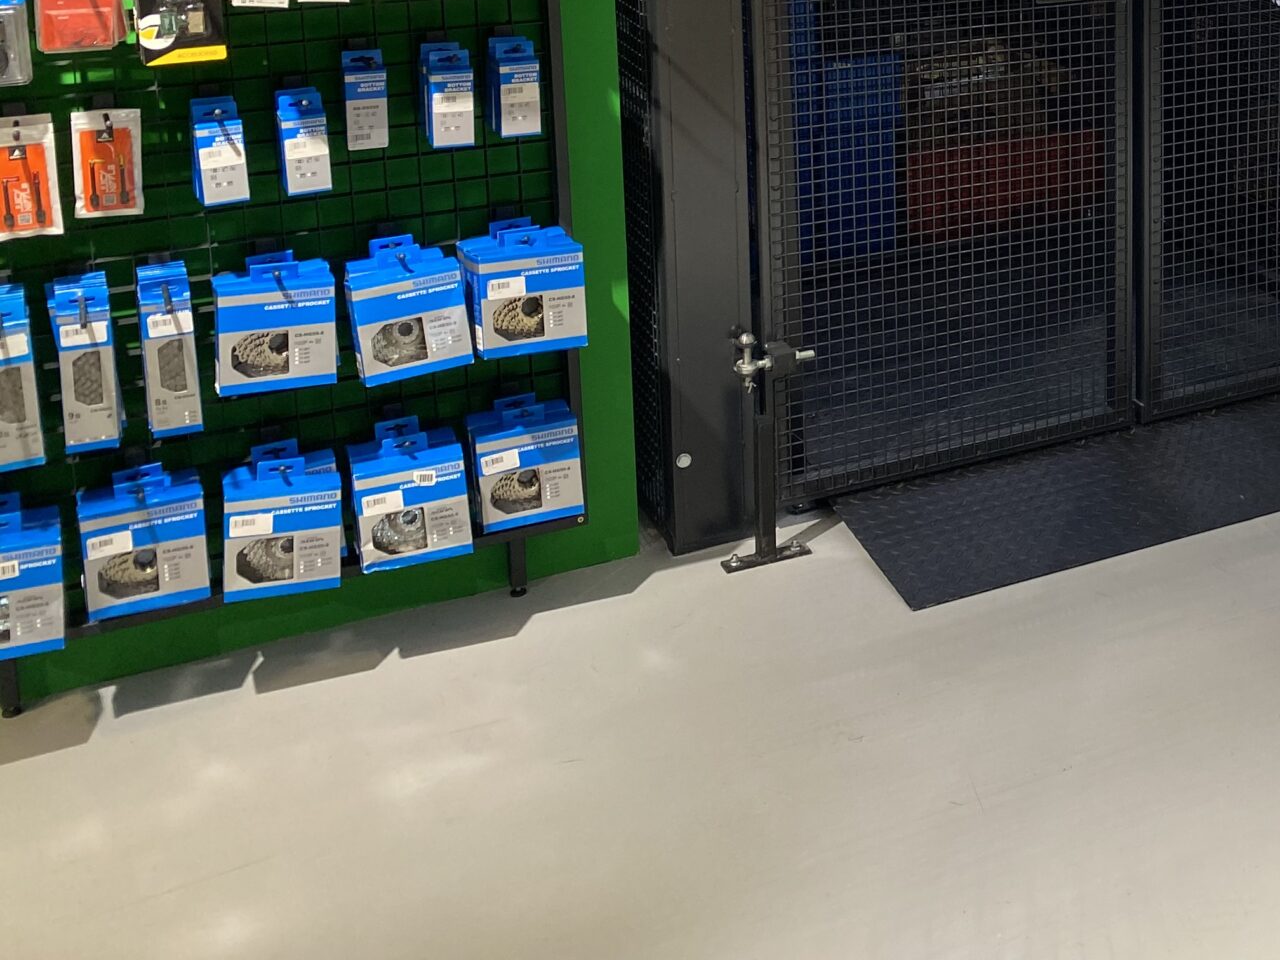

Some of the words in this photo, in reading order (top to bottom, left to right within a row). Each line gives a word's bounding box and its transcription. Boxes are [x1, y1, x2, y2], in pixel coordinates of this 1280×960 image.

[536, 254, 580, 266] SHIMANO
[520, 268, 550, 276] CASSETTE
[550, 264, 580, 273] SPROCKET
[412, 272, 458, 287] SHIMANO
[283, 288, 331, 300] SHIMANO
[396, 289, 427, 300] CASSETTE
[427, 283, 459, 294] SPROCKET
[297, 299, 331, 308] SPROCKET
[530, 427, 574, 440] SHIMANO
[545, 437, 575, 448] SPROCKET
[288, 492, 337, 504] SHIMANO
[146, 501, 198, 517] SHIMANO
[303, 503, 337, 512] SPROCKET
